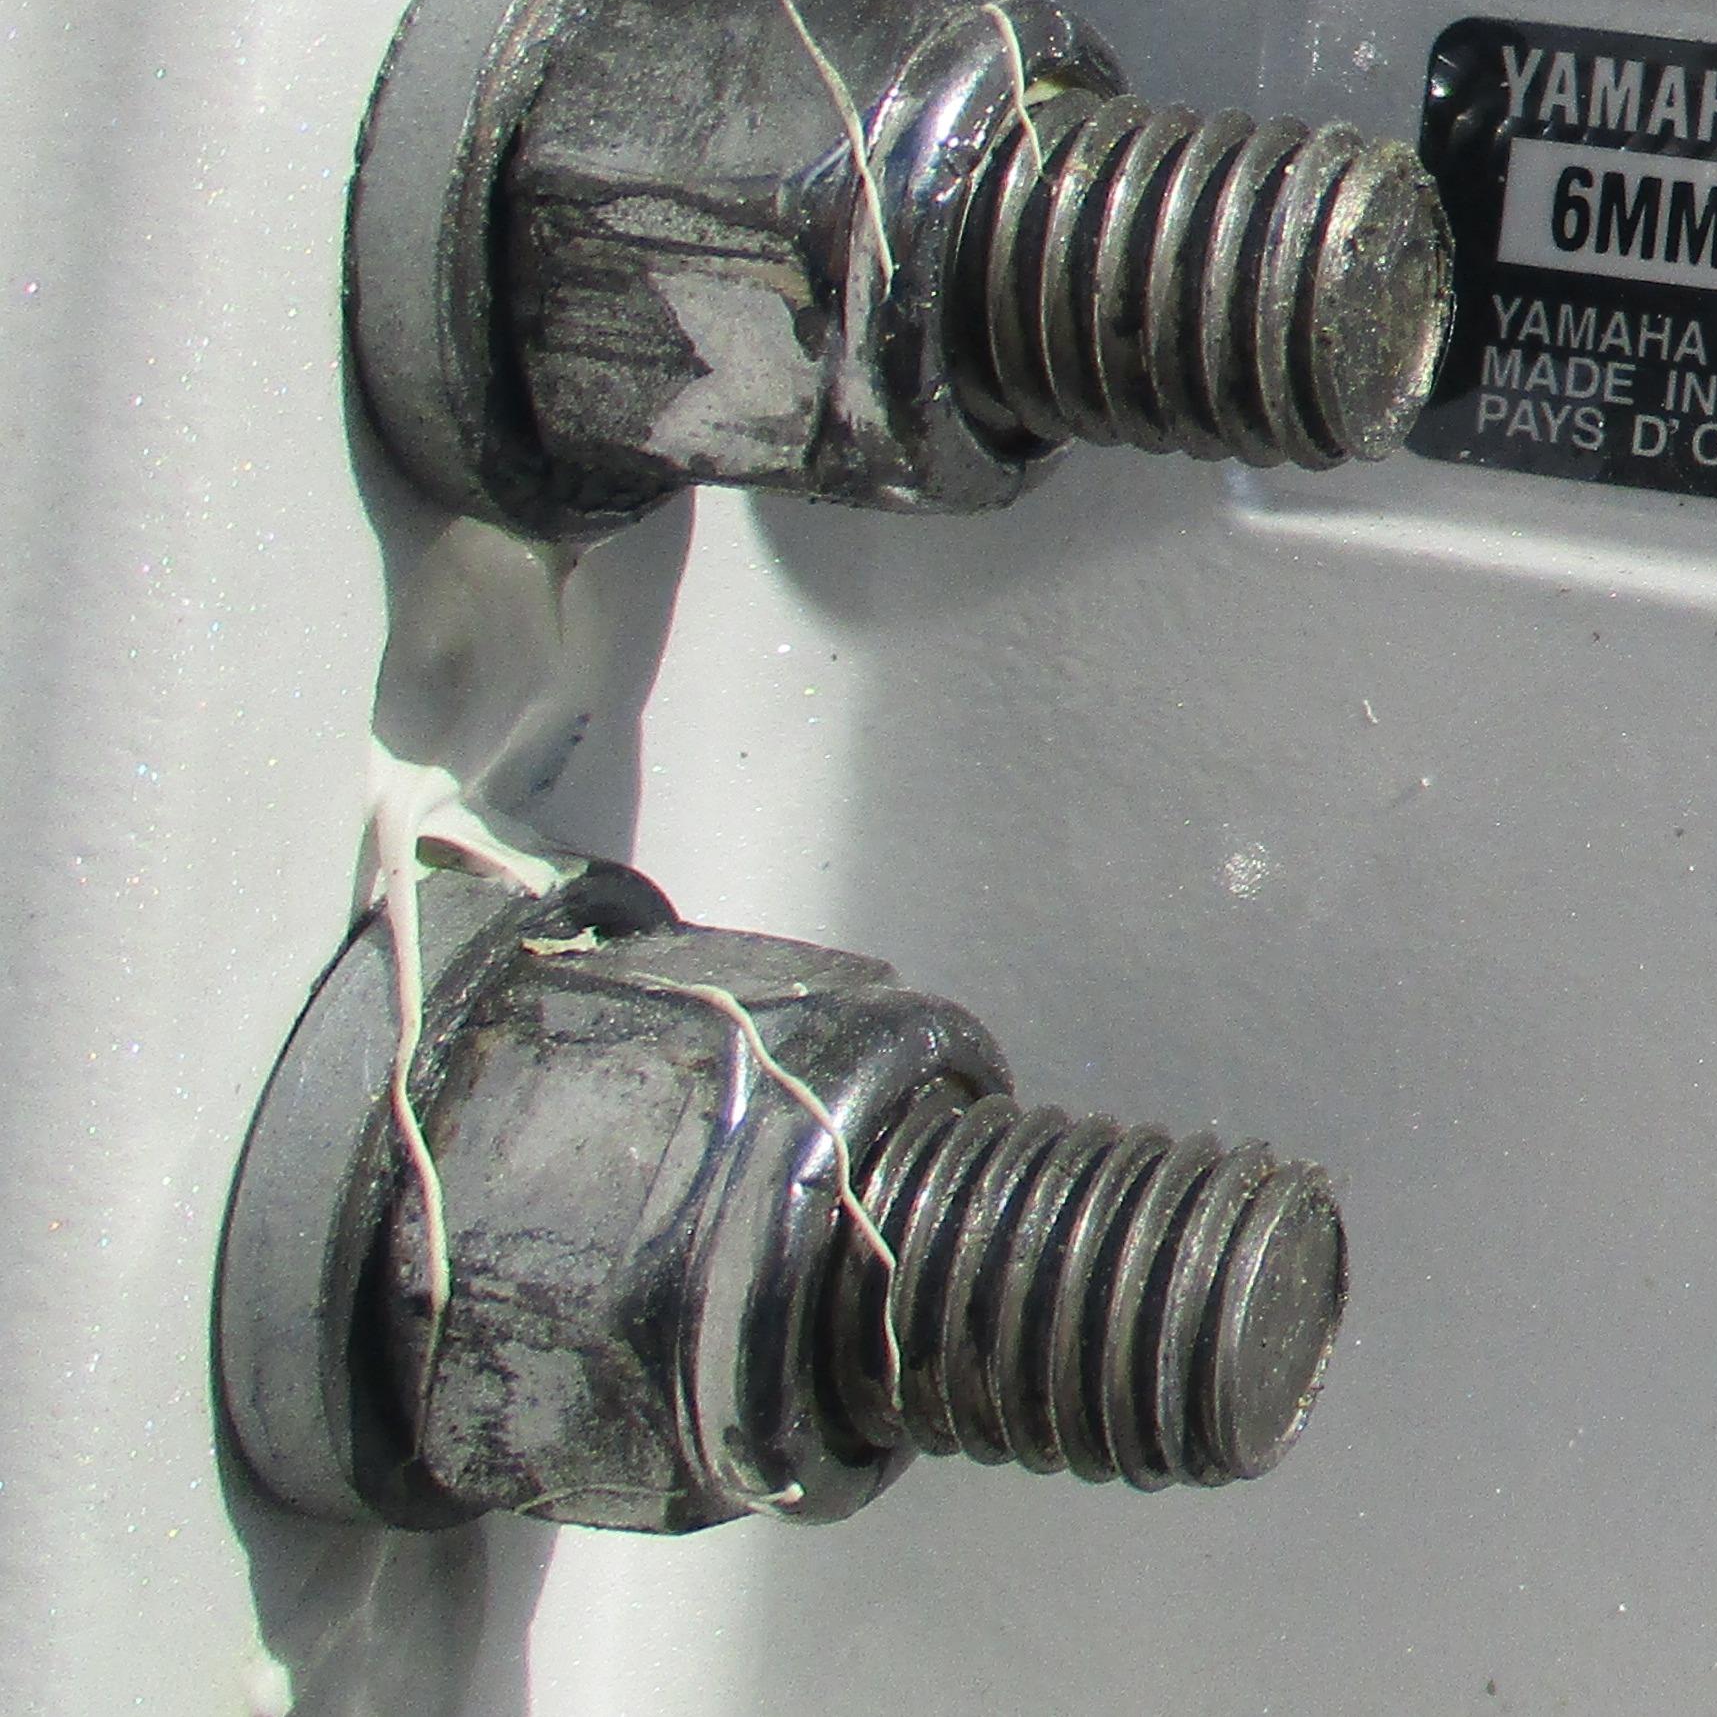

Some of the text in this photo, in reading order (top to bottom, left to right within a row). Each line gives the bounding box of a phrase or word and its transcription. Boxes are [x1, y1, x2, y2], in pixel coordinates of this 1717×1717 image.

[1491, 294, 1708, 366] YAMAHA
[1480, 345, 1638, 406] MADE
[1476, 393, 1606, 452] PAYS
